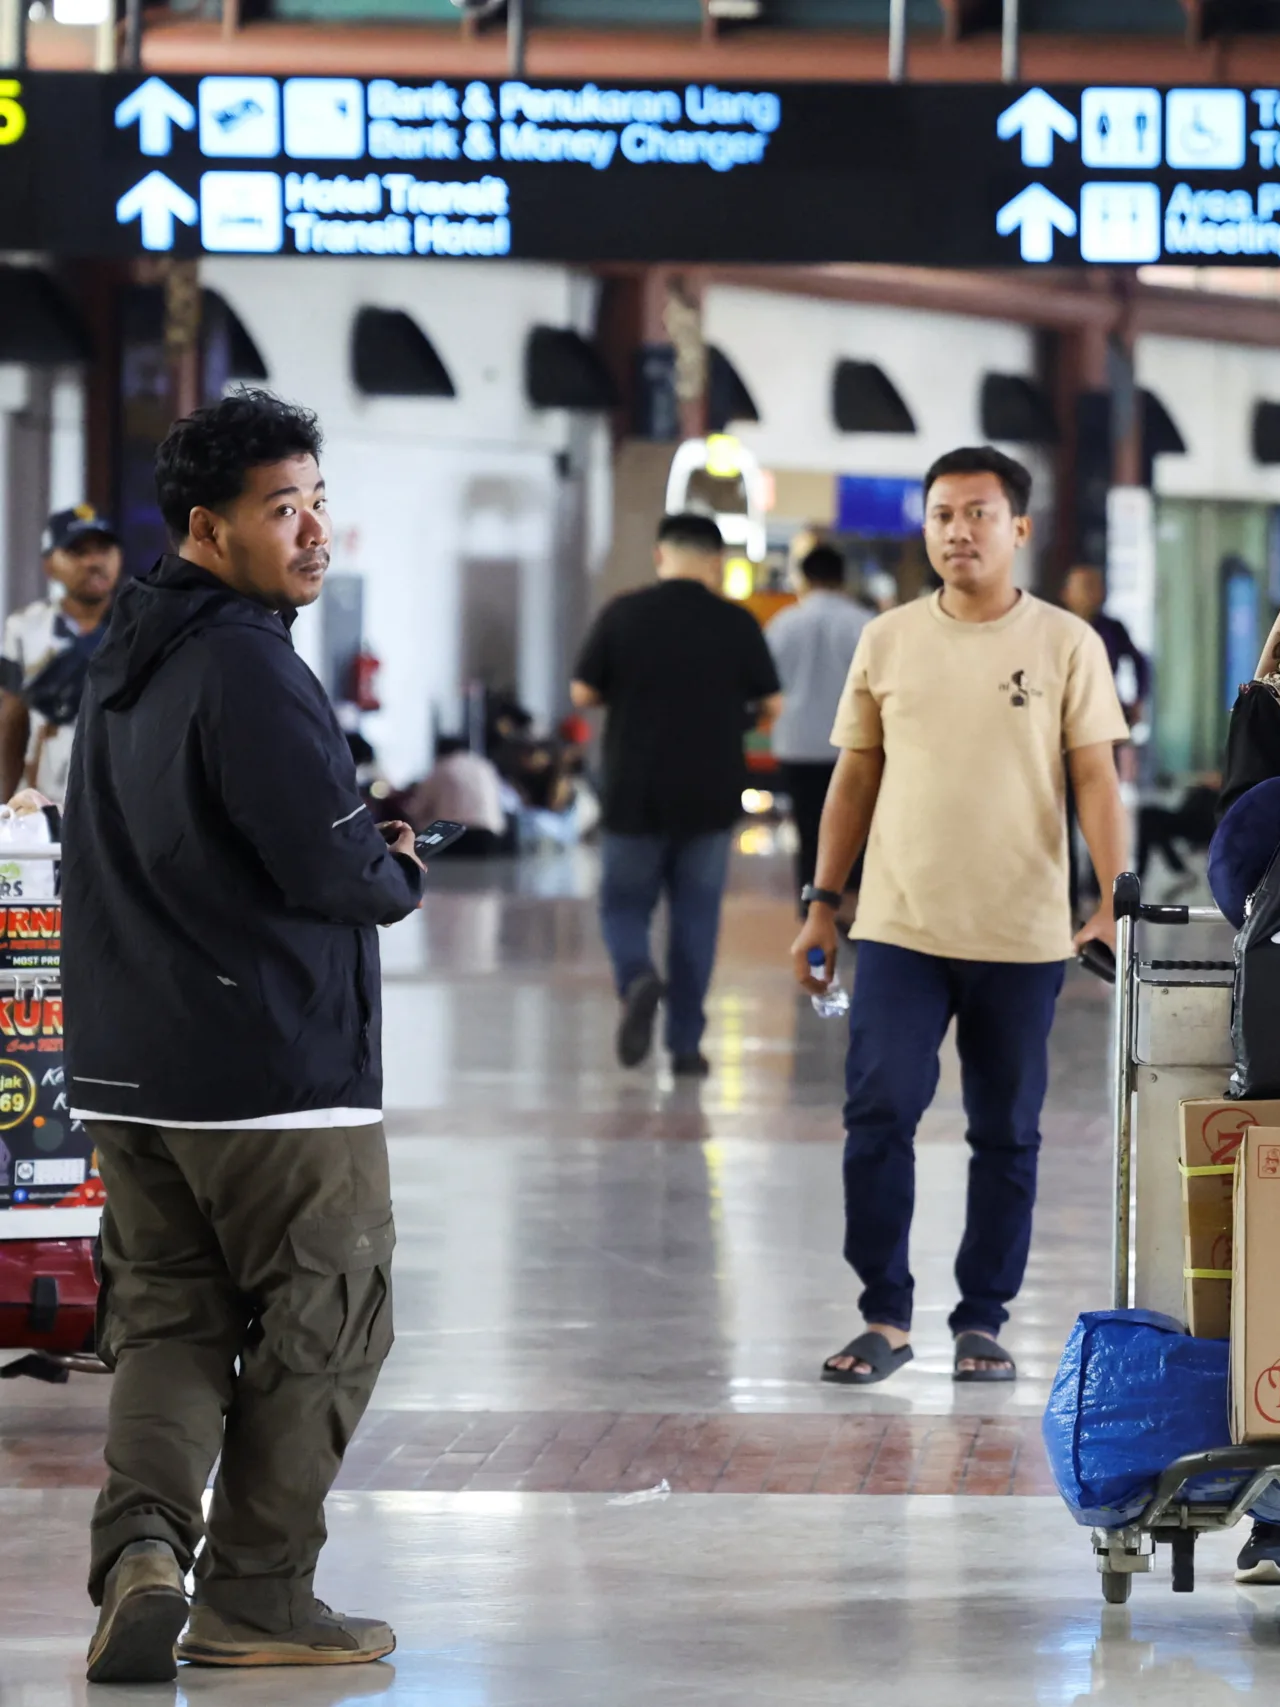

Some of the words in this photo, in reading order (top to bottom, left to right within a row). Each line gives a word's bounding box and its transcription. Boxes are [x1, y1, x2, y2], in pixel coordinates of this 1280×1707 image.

[367, 79, 458, 120] Bank
[462, 81, 495, 120] &
[499, 81, 681, 124] Penukaran
[685, 85, 781, 133] Uang
[367, 119, 459, 159] Bank
[462, 120, 496, 160] &
[499, 121, 618, 170] Money
[620, 123, 769, 172] Changer
[285, 172, 382, 214] Hotel
[382, 173, 509, 216] Transit
[1165, 182, 1253, 222] Area
[286, 212, 412, 254] Transit
[414, 214, 511, 255] Hotel
